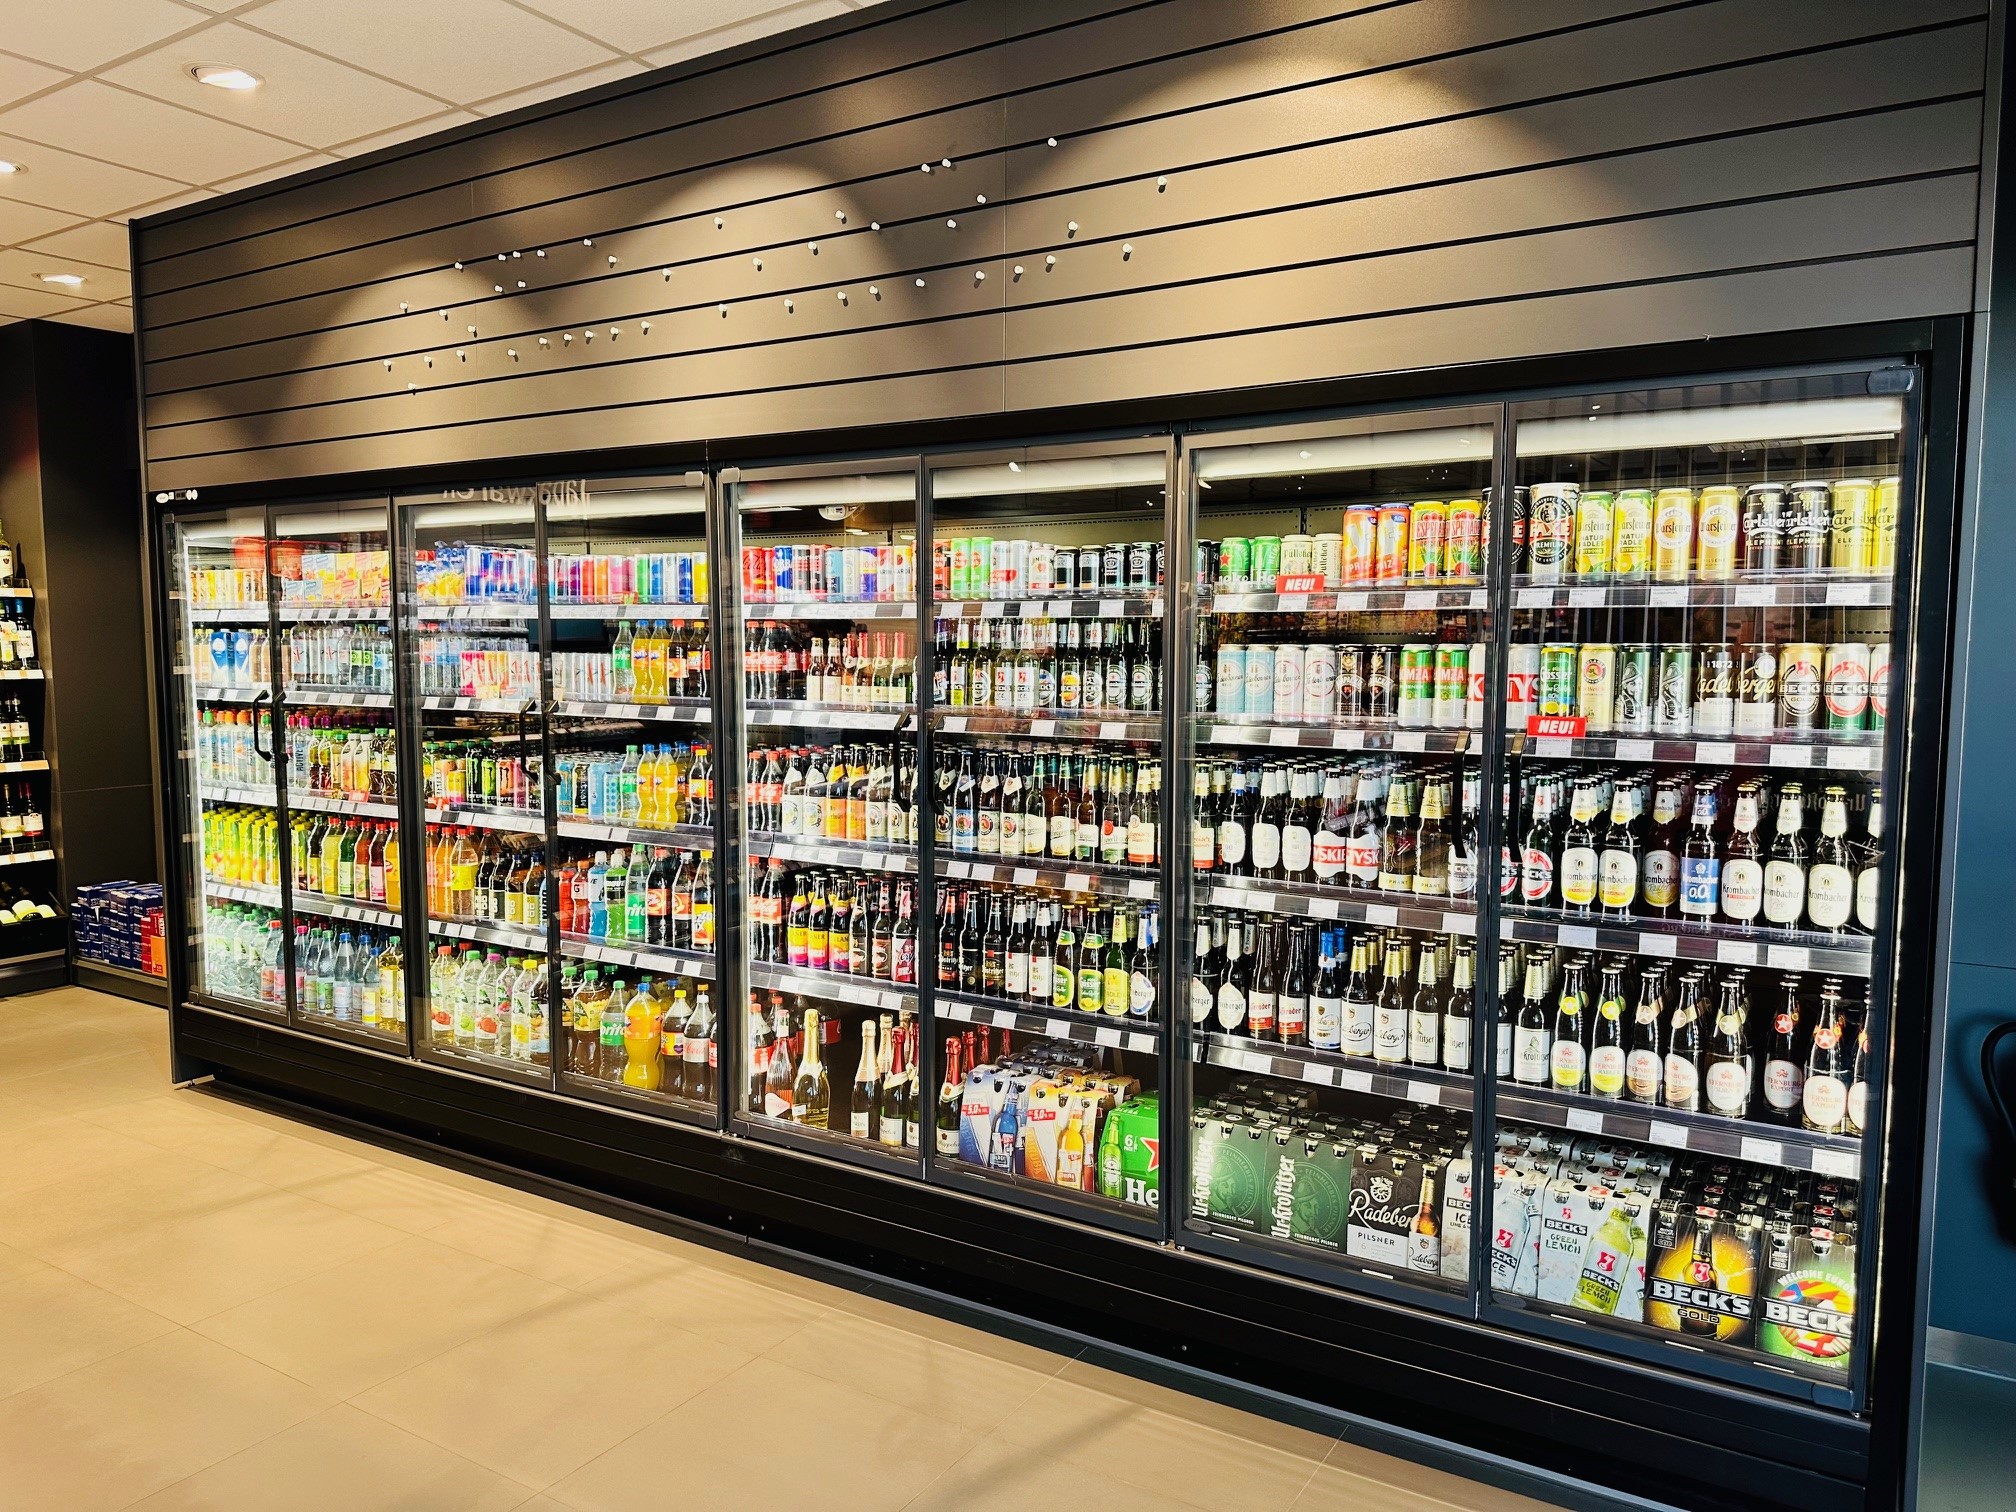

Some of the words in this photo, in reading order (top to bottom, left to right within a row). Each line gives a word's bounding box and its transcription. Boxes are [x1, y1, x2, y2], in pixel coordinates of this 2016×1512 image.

[1284, 578, 1316, 591] NEU!
[1711, 660, 1733, 668] 1872
[1780, 684, 1821, 694] BECK'S
[1826, 684, 1868, 694] BECK'S
[1537, 720, 1575, 735] NEU!
[295, 749, 304, 772] ACTIVE
[574, 885, 580, 893] G
[1722, 884, 1760, 895] Krombacher
[1708, 1080, 1743, 1089] STERNBURG
[1766, 1076, 1801, 1087] STERNBURG
[1125, 1134, 1133, 1146] 6
[1212, 1211, 1237, 1222] FEINHERBES
[1237, 1216, 1255, 1225] PILSNER
[1546, 1219, 1587, 1236] BECK'S
[1294, 1233, 1320, 1243] FEINHERBES
[1320, 1239, 1339, 1247] PILSNER
[1358, 1232, 1395, 1246] PILSNER
[1551, 1233, 1577, 1245] GREEN
[1545, 1239, 1581, 1254] LEMON
[1583, 1269, 1619, 1291] BECK'S
[1778, 1270, 1823, 1286] WELCOME
[1581, 1285, 1611, 1304] LEMON
[1587, 1281, 1610, 1296] GREEN
[1654, 1281, 1749, 1316] BECK'S
[1678, 1308, 1720, 1325] GOLD
[1766, 1302, 1854, 1334] BECK
